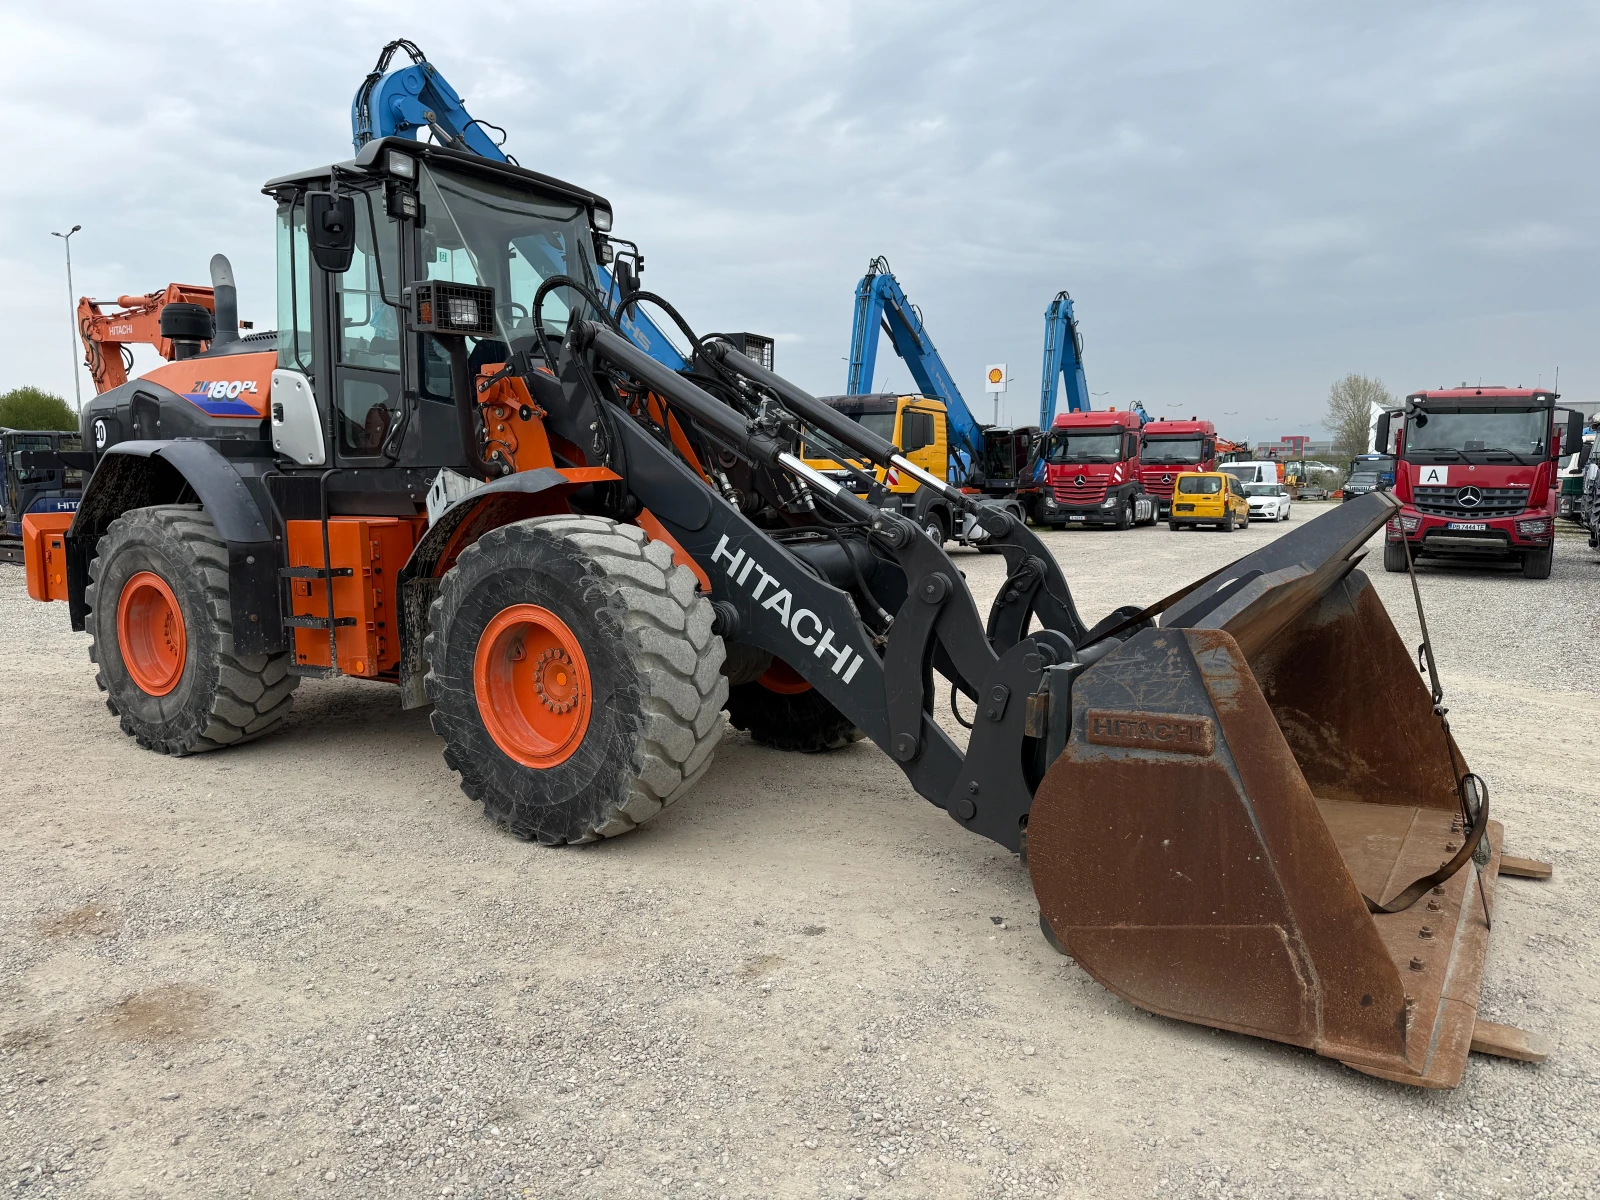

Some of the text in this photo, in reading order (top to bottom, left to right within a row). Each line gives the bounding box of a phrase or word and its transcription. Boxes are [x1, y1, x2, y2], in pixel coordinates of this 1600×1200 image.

[109, 324, 133, 336] HITACHI
[1427, 469, 1440, 482] A
[711, 533, 864, 685] HITACHI
[1094, 718, 1201, 742] HITACHI
